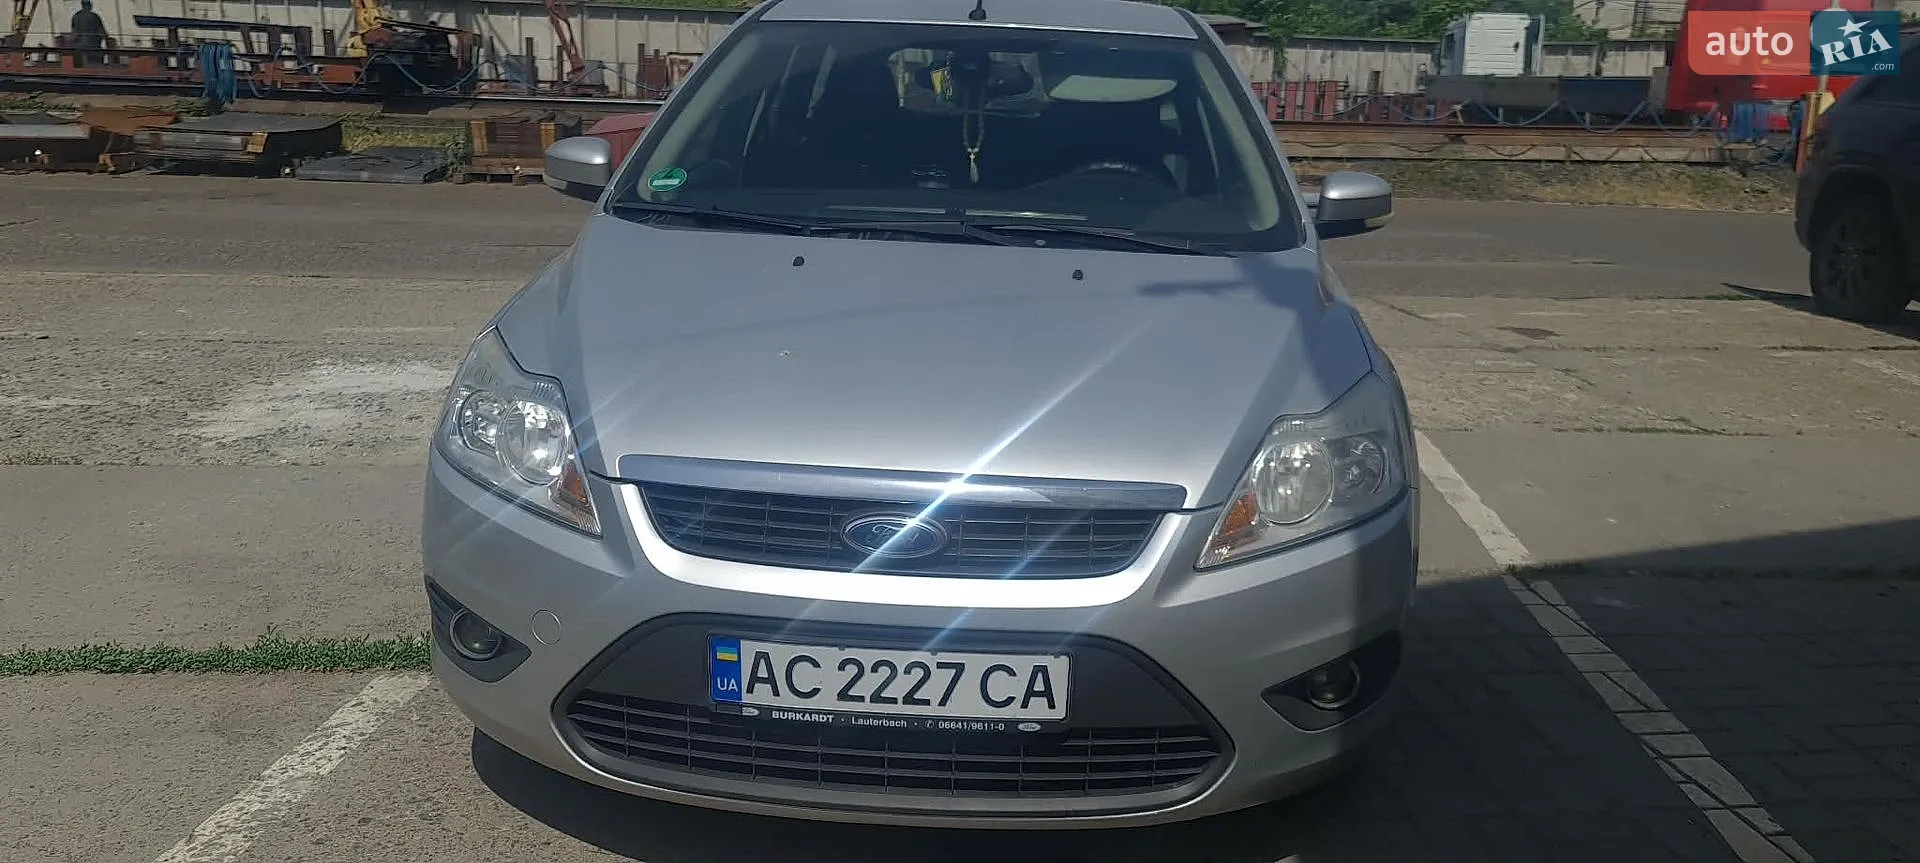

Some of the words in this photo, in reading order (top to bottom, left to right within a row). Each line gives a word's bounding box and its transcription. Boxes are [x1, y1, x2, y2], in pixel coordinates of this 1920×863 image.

[717, 676, 738, 691] UA
[746, 650, 822, 699] AC
[836, 657, 965, 706] 2227
[979, 664, 1056, 709] CA
[772, 711, 834, 723] BURKARDT
[851, 716, 907, 728] Lauterbach
